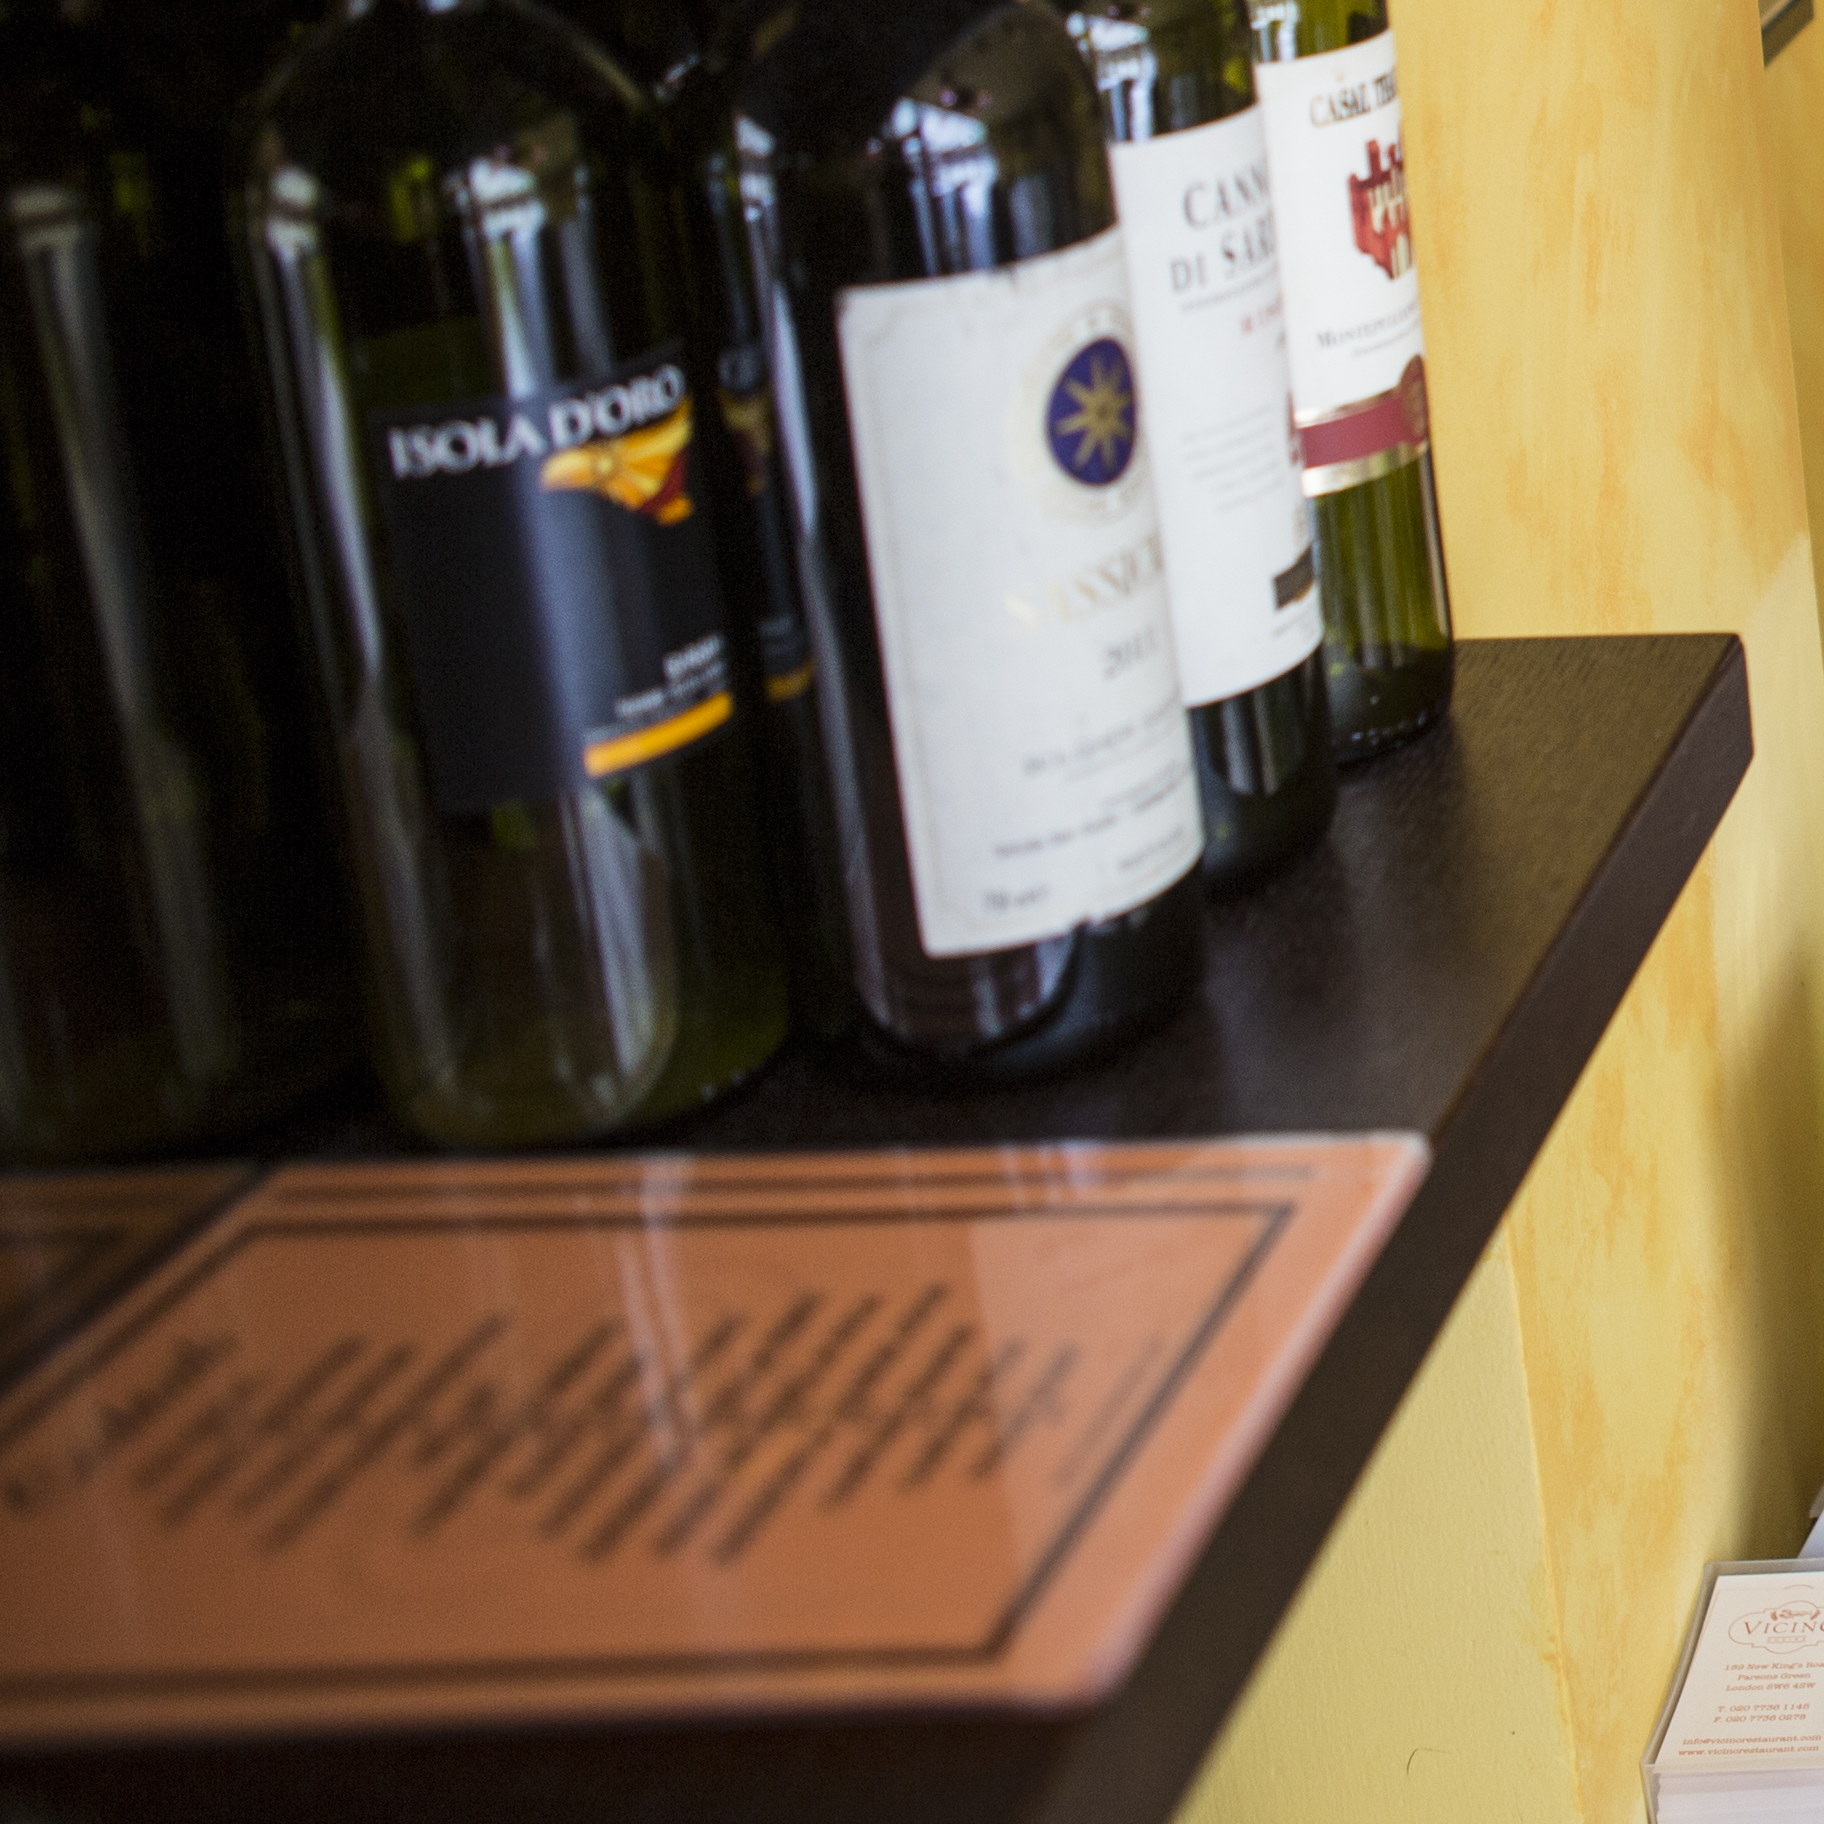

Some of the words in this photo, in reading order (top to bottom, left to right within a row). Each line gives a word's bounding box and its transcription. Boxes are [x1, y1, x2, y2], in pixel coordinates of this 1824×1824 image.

[388, 414, 547, 479] ISOLA
[549, 363, 686, 449] D'ORO
[1678, 1745, 1820, 1756] www.vicinorestaurant.com
